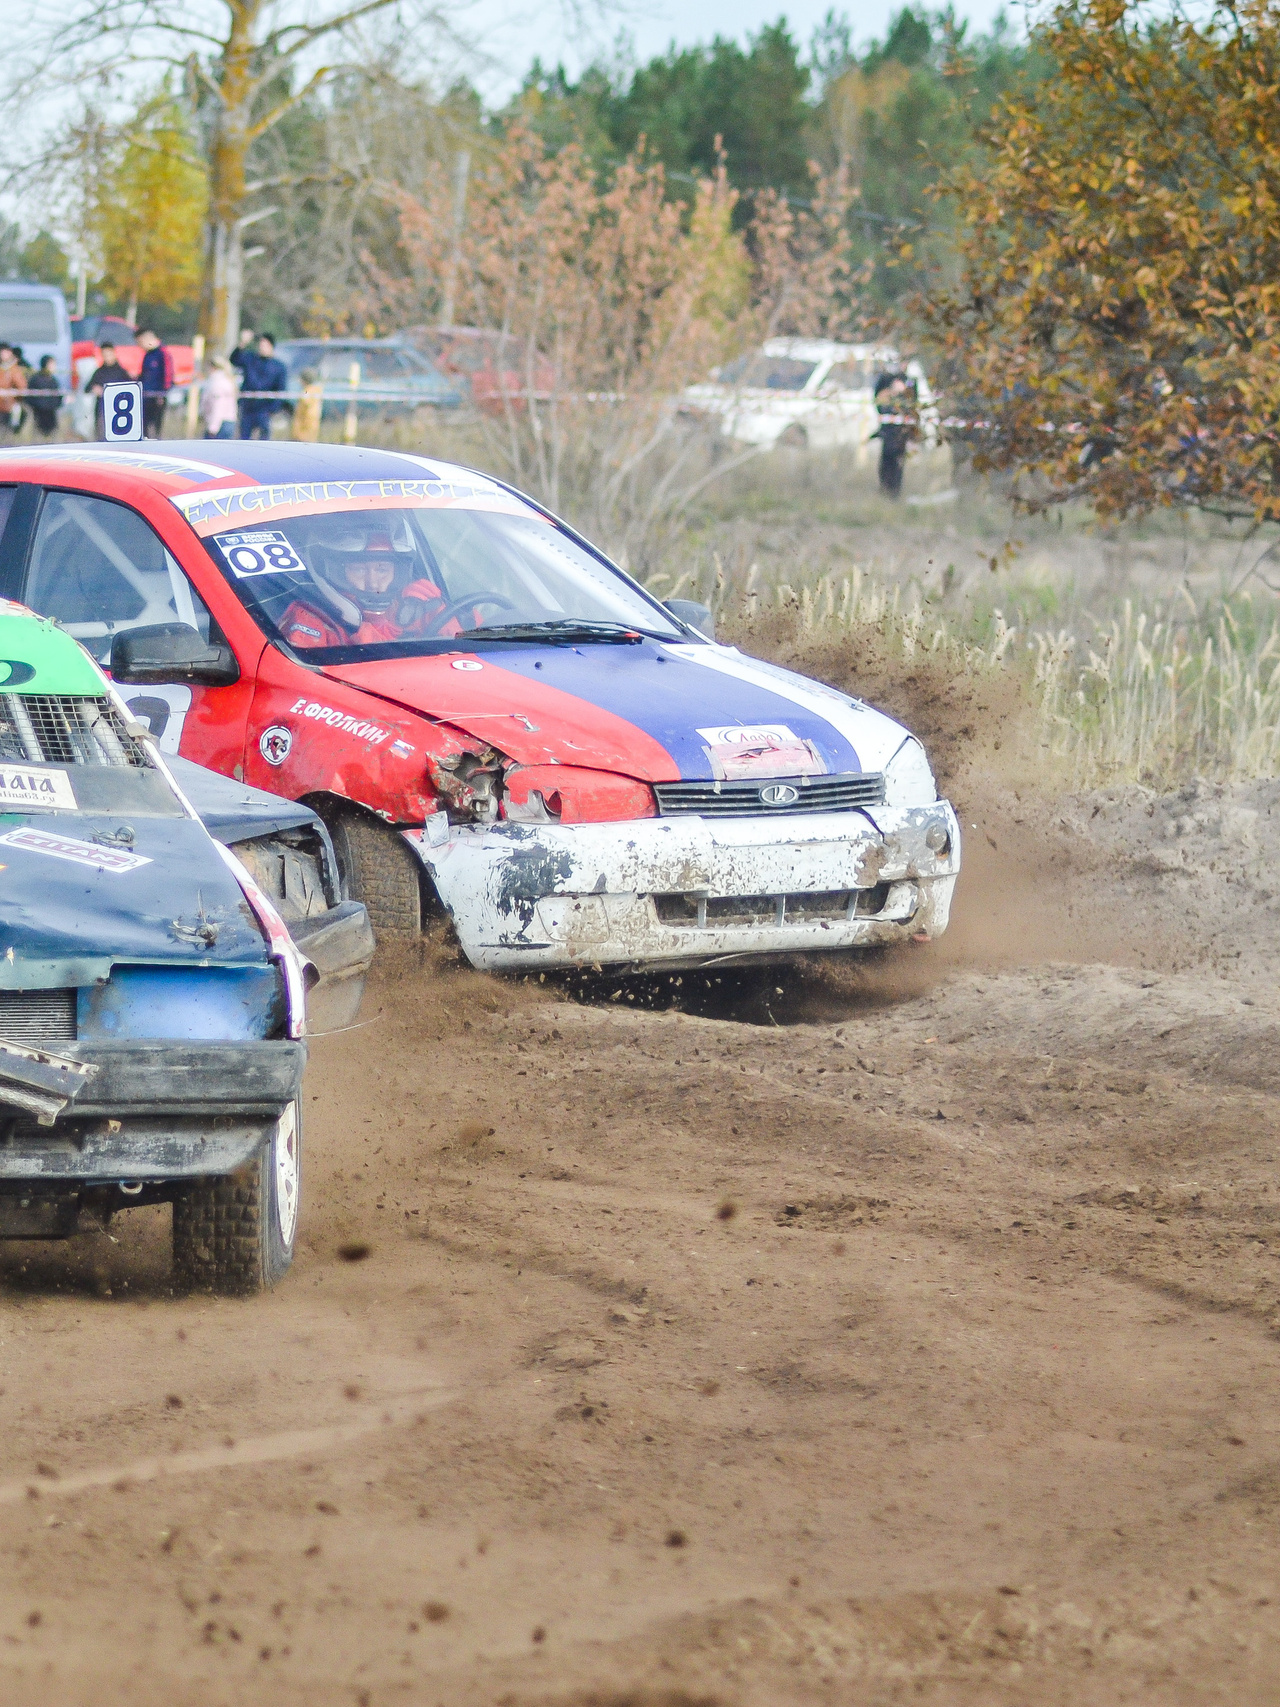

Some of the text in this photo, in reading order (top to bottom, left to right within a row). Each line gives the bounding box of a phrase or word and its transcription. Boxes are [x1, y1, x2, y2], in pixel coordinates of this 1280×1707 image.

[111, 391, 134, 436] 8
[183, 482, 357, 525] EVGENIY
[229, 543, 299, 573] 08
